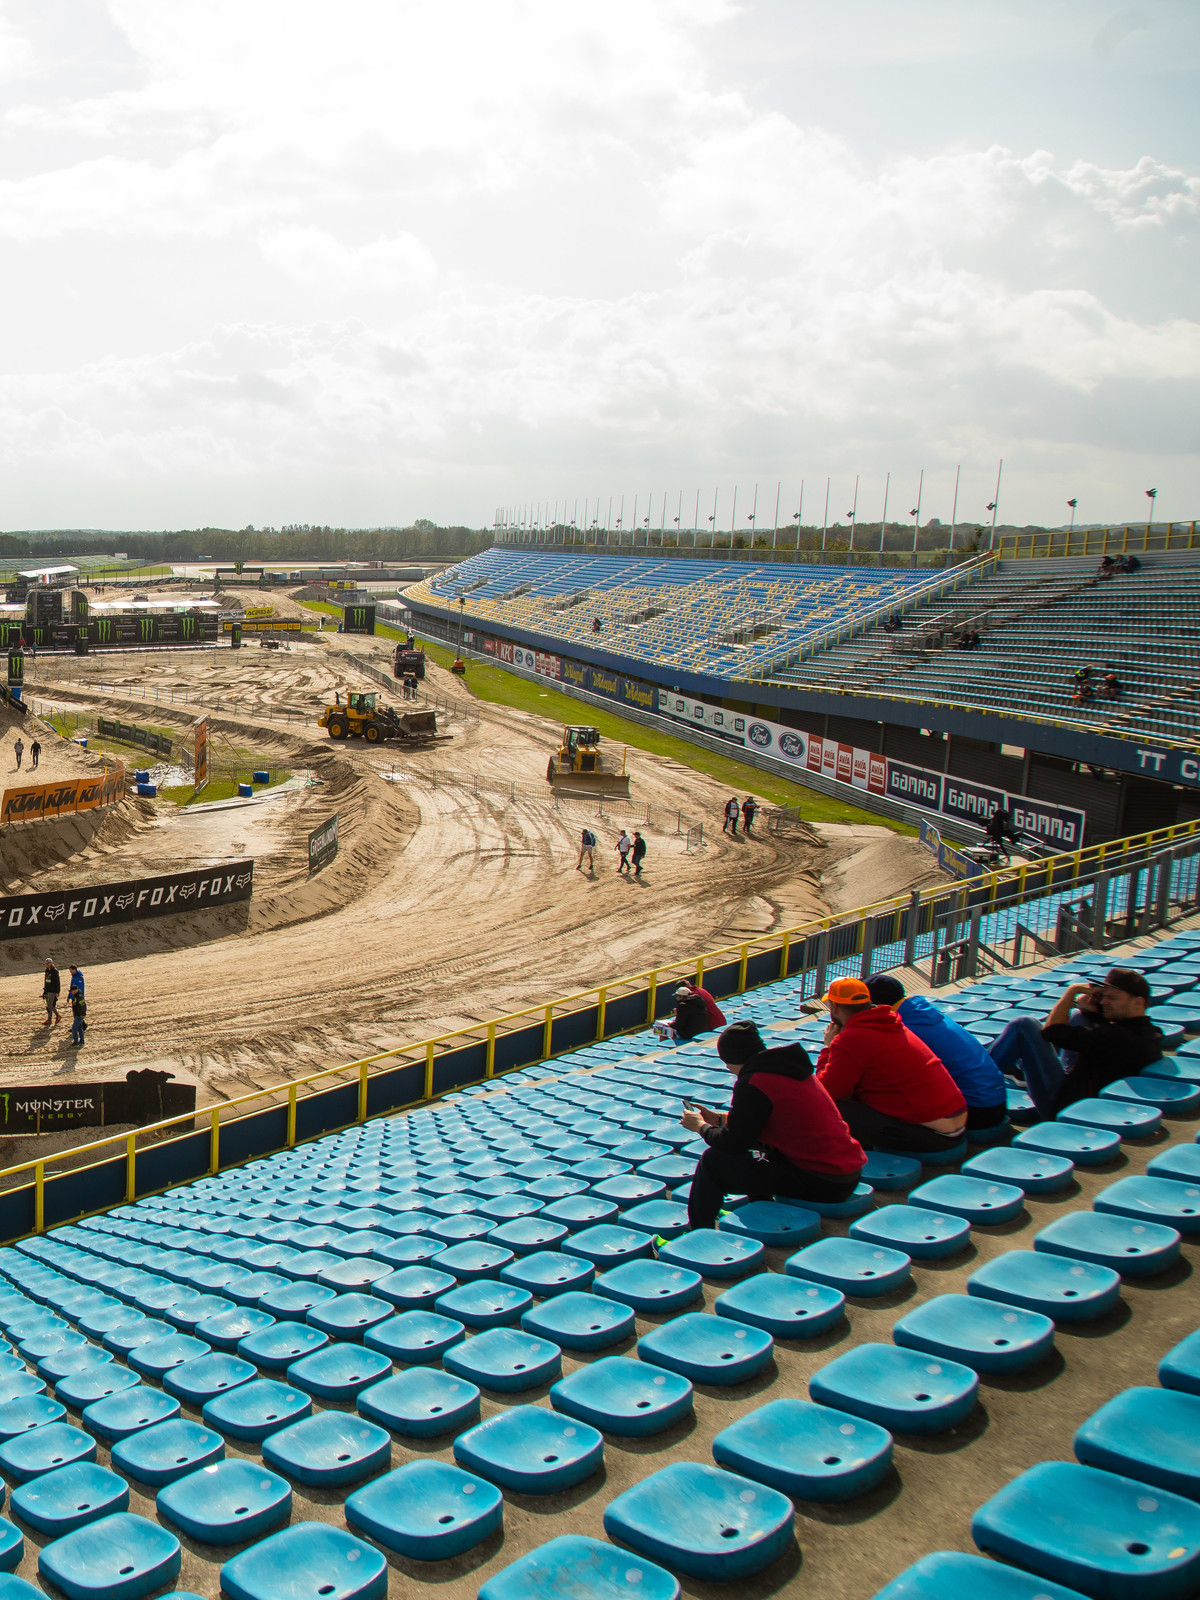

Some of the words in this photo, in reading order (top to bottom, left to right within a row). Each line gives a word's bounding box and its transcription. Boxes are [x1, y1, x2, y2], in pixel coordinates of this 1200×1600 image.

[500, 643, 512, 662] KFC
[1136, 749, 1167, 771] TT
[1181, 759, 1200, 780] C
[4, 792, 43, 815] KTM
[45, 787, 77, 809] KTM
[135, 885, 179, 908] FOX
[198, 874, 235, 898] FOX
[68, 895, 115, 920] FOX
[16, 1098, 95, 1112] MONSTER
[28, 1111, 87, 1121] ENERGY
